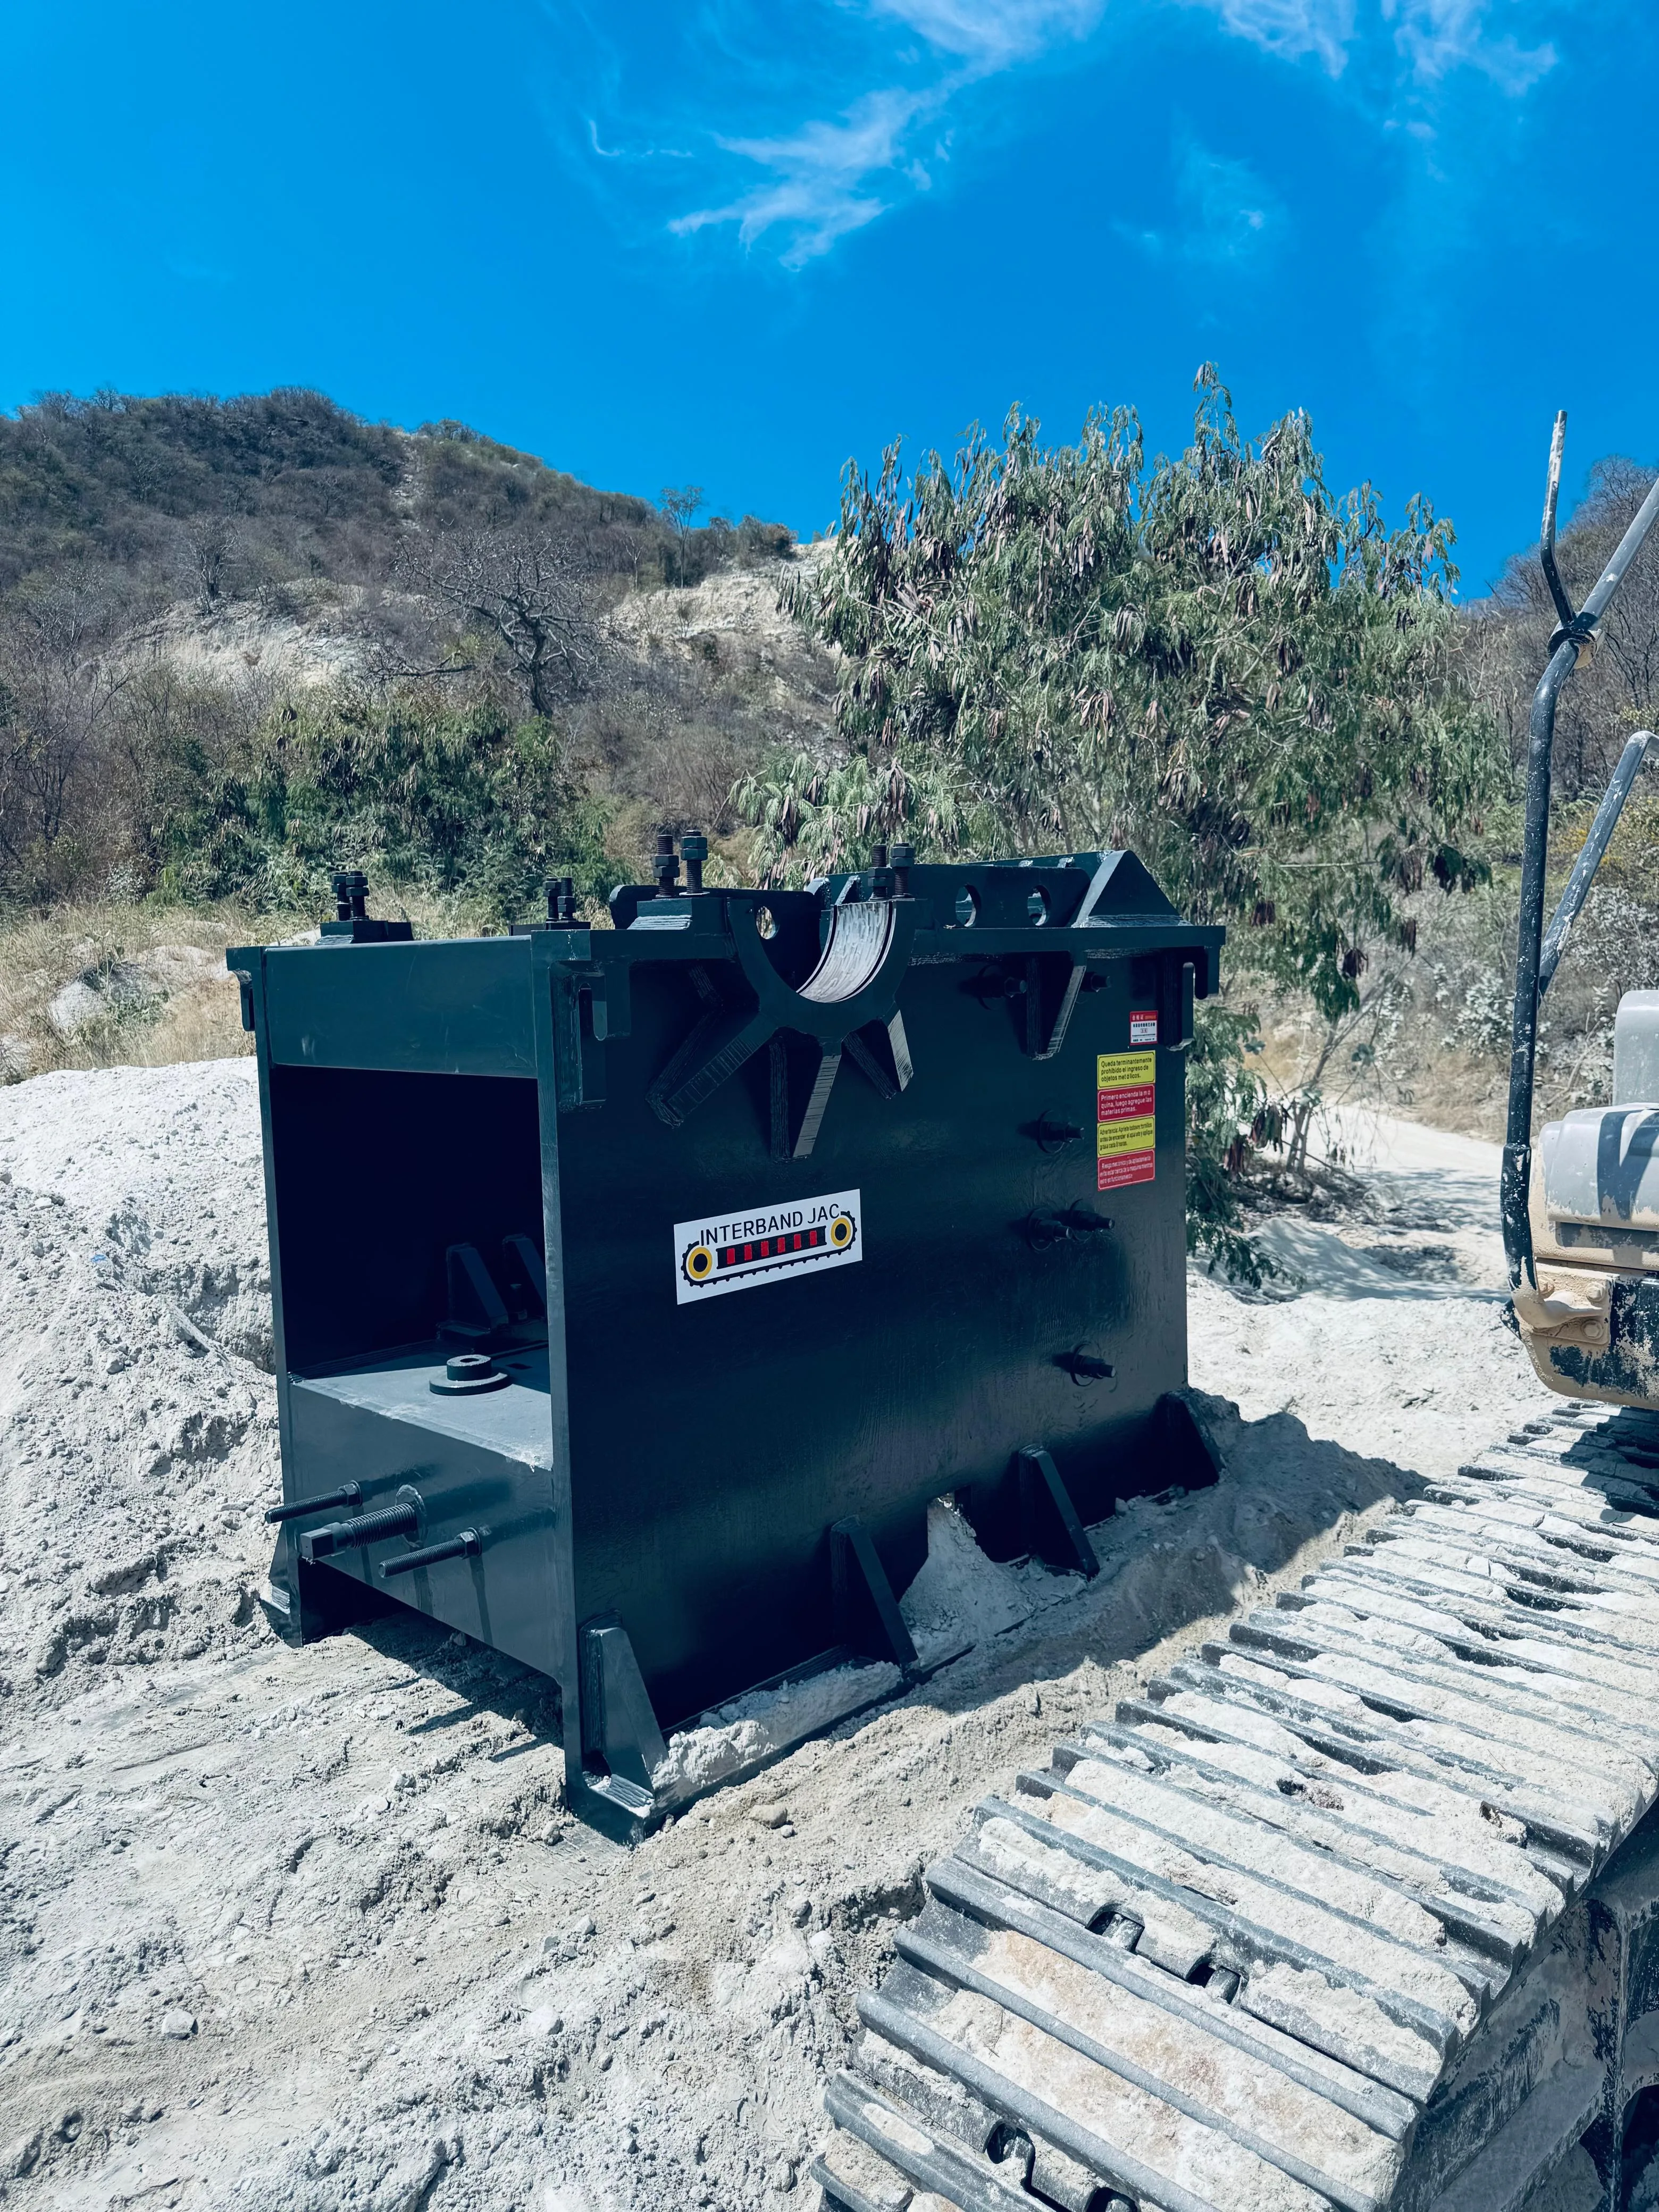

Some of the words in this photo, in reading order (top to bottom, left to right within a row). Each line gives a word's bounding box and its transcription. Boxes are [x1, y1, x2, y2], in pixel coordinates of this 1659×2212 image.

[1101, 1067, 1122, 1075] prohibido
[700, 1211, 803, 1246] INTERBAND
[807, 1203, 840, 1224] JAC
